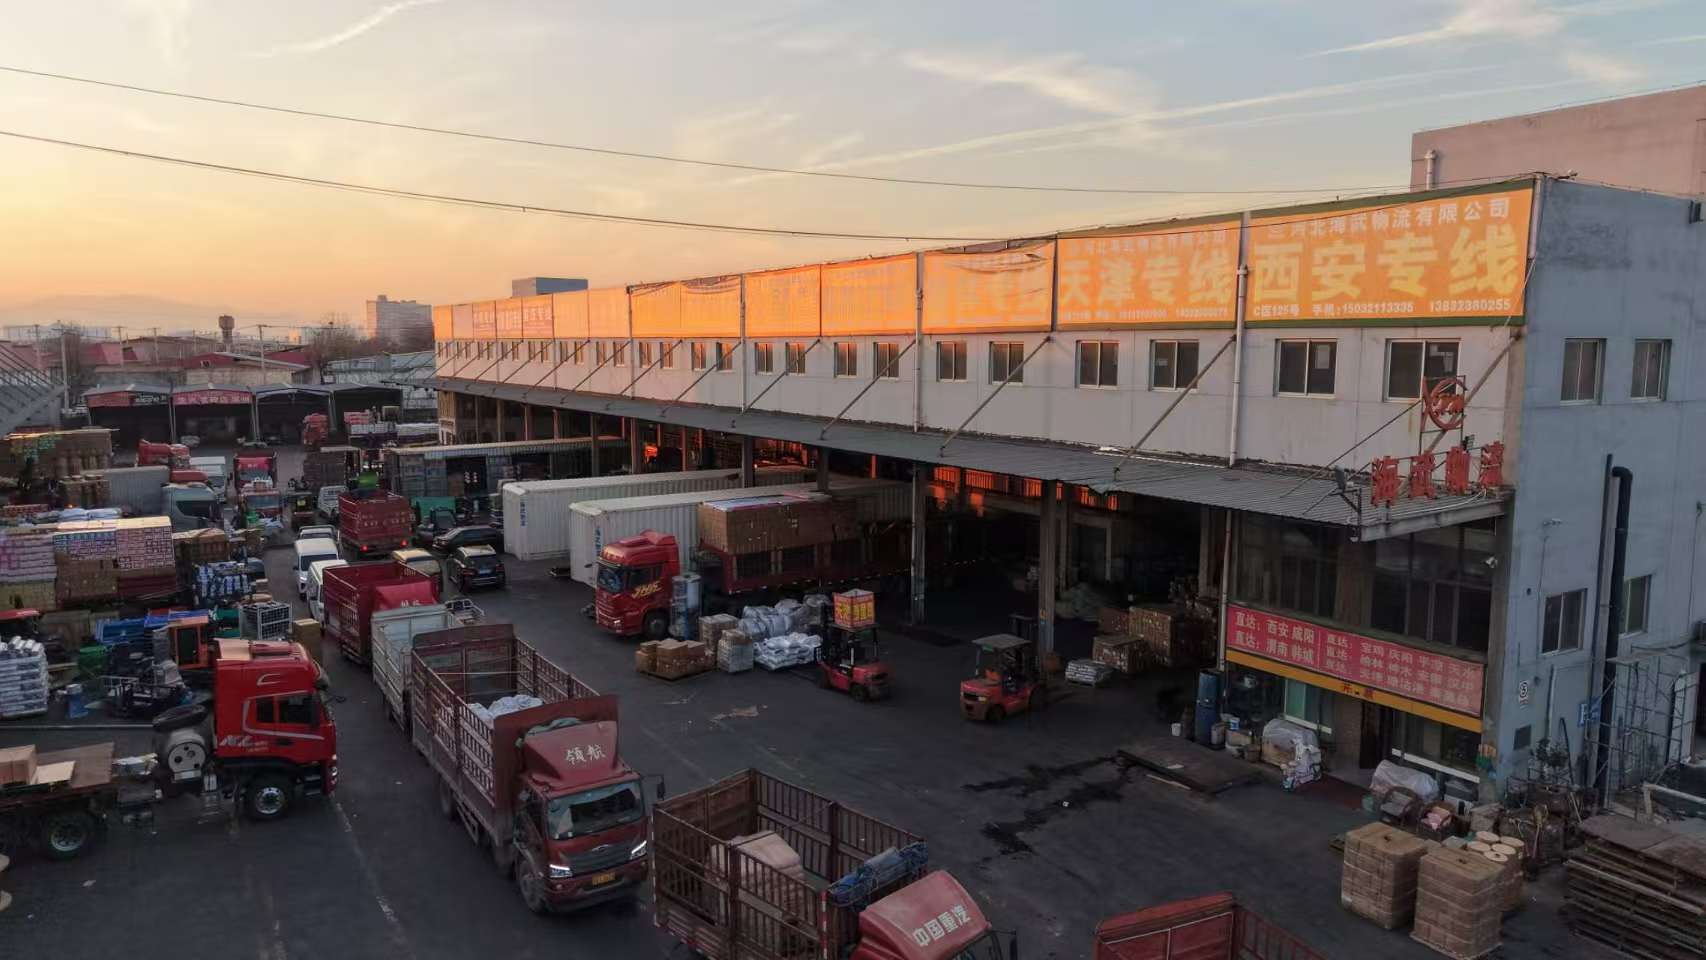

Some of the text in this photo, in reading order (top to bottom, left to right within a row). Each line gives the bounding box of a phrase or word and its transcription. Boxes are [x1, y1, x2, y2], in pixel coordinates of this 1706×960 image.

[1061, 247, 1231, 306] 天津专线
[1253, 224, 1520, 304] 西安专线
[1265, 618, 1289, 640] 西安
[564, 743, 607, 765] 领航
[912, 903, 971, 947] 中国重汽
